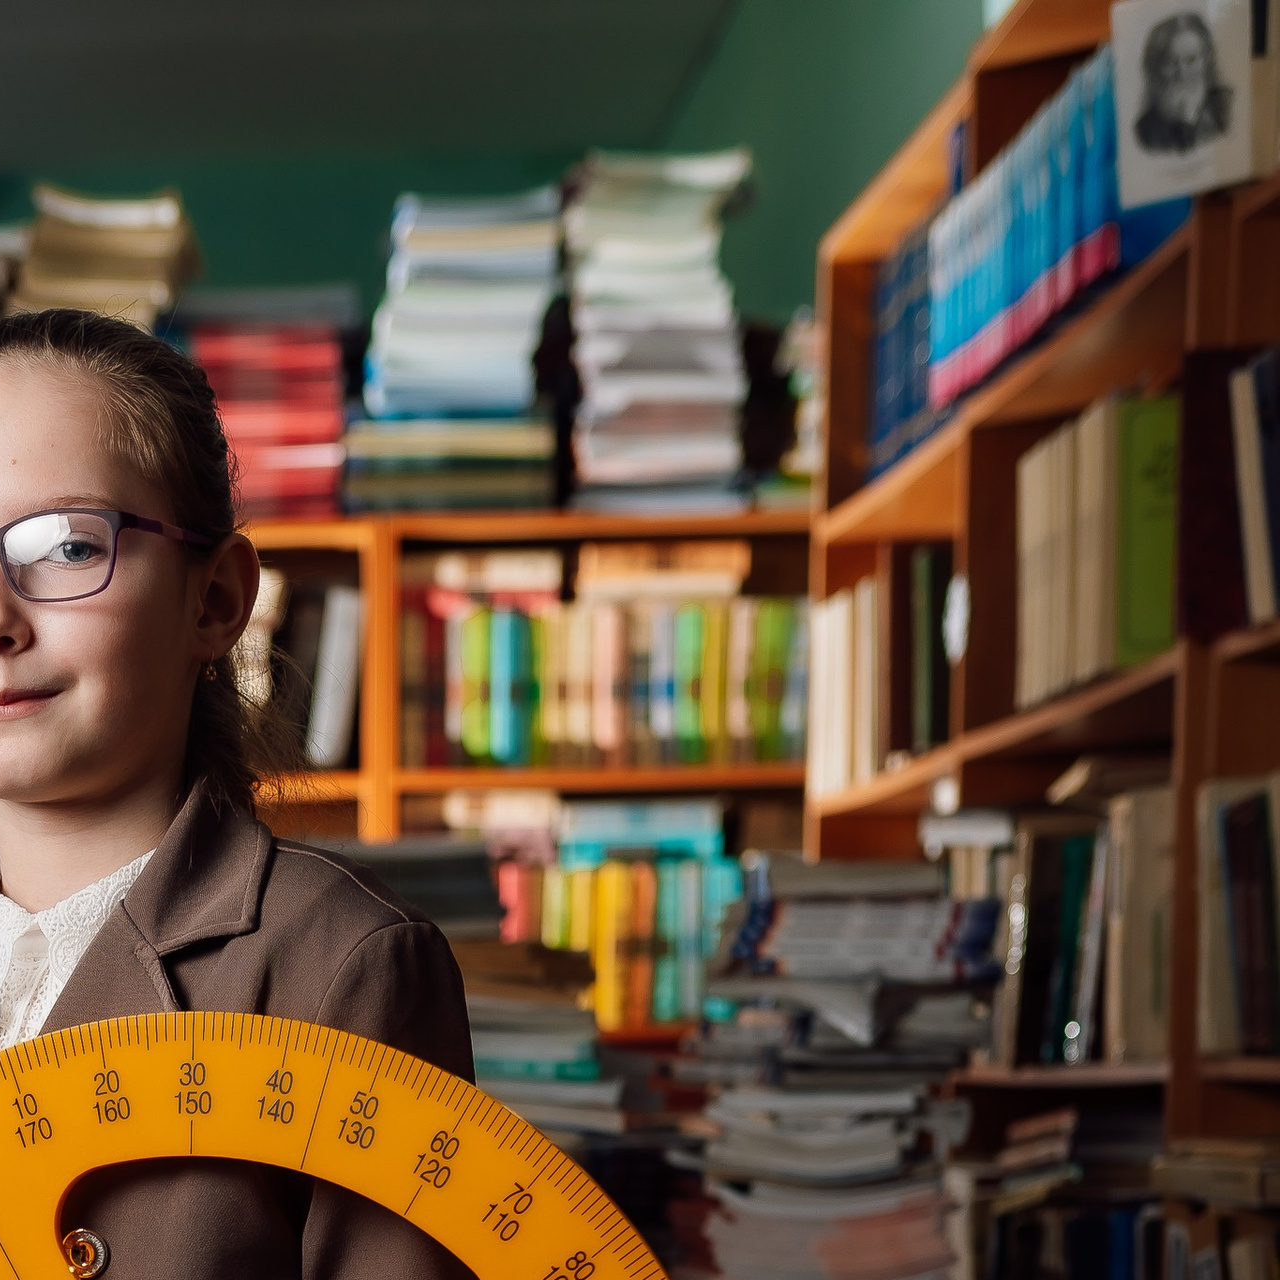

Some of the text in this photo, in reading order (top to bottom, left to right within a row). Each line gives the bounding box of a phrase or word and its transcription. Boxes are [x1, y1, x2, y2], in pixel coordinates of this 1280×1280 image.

[93, 1070, 120, 1097] 20
[179, 1063, 206, 1087] 30
[265, 1070, 294, 1095] 40
[12, 1093, 38, 1120] 10
[92, 1097, 131, 1124] 160
[174, 1091, 212, 1115] 150
[257, 1097, 295, 1125] 140
[349, 1091, 379, 1121] 50
[15, 1117, 53, 1149] 170
[338, 1117, 376, 1150] 130
[429, 1130, 460, 1160] 60
[412, 1153, 452, 1189] 120
[503, 1182, 533, 1215] 70
[481, 1203, 520, 1242] 110
